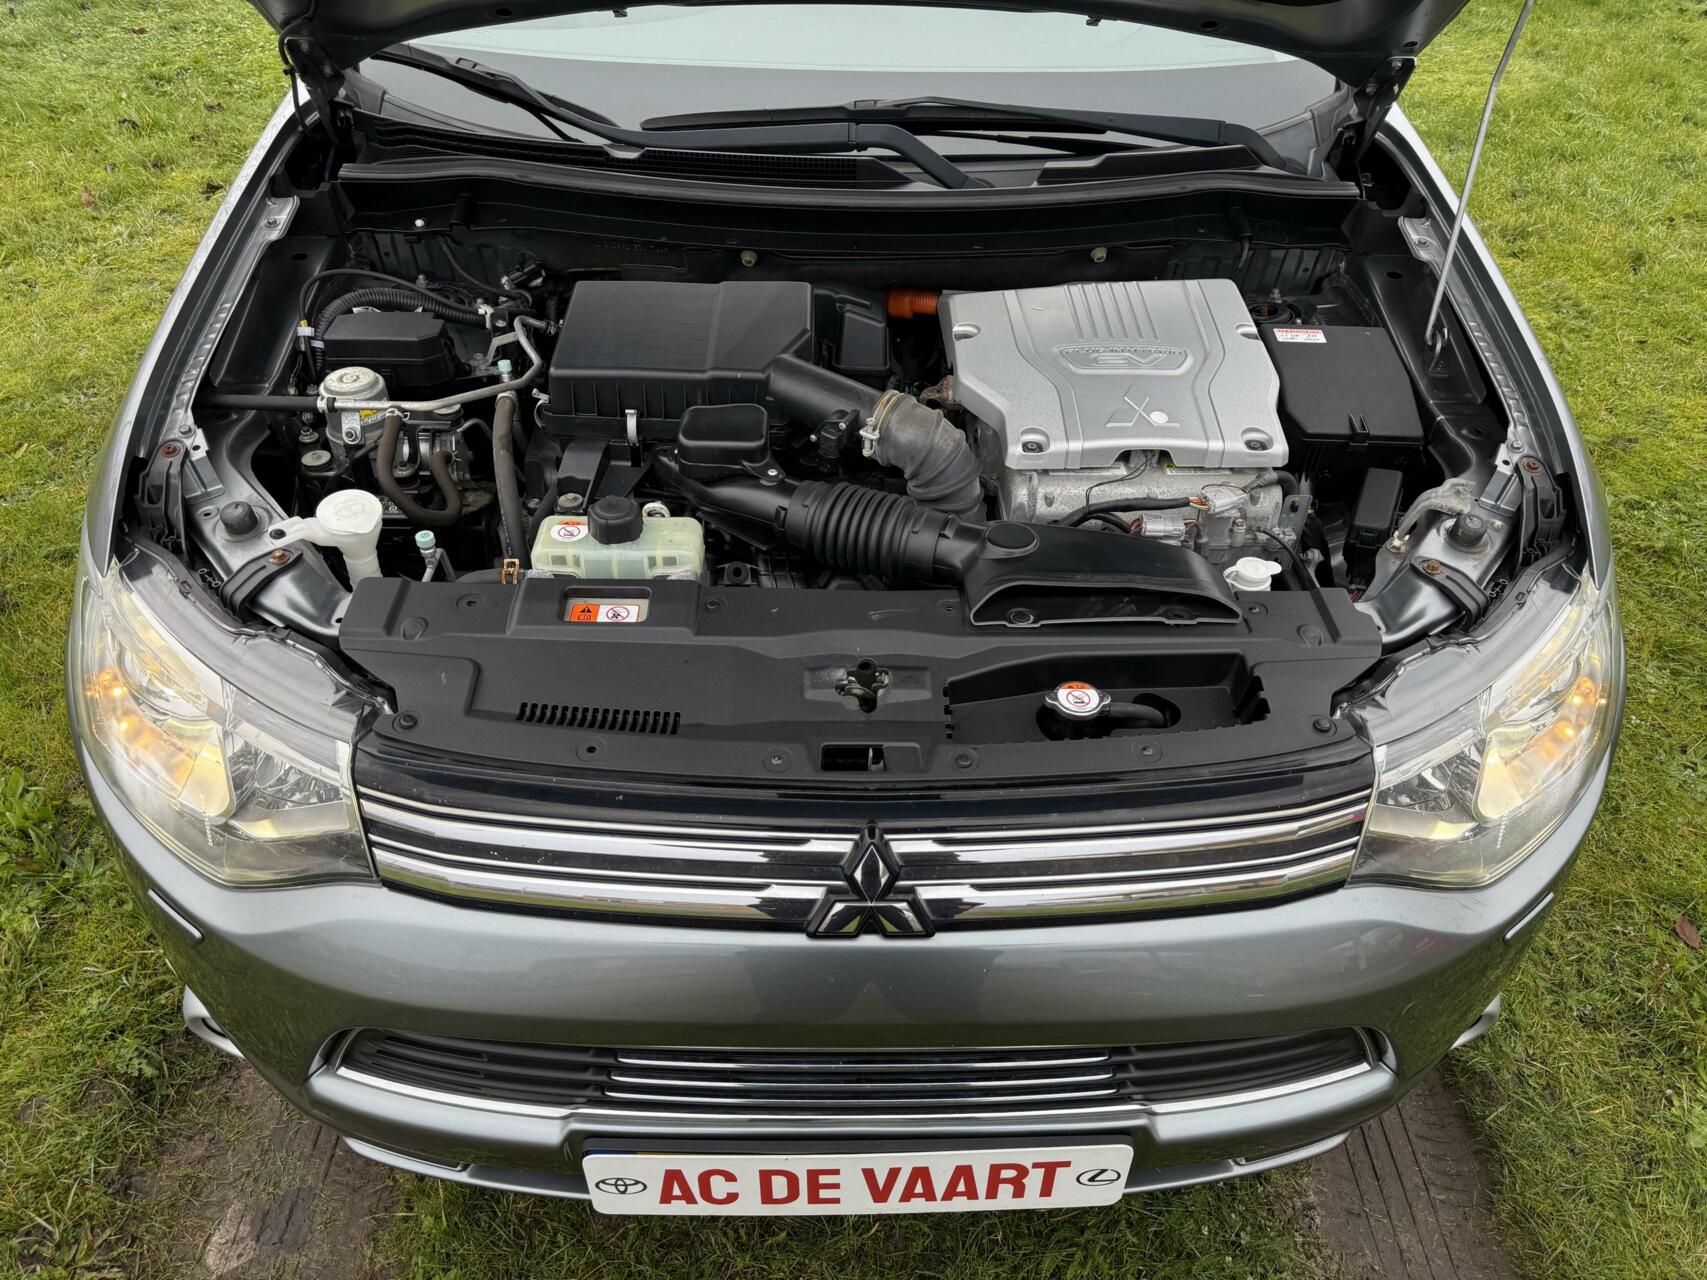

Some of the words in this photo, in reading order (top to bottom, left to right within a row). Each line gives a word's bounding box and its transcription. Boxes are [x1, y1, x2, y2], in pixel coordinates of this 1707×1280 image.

[659, 1169, 739, 1205] AC
[759, 1169, 840, 1205] DE
[862, 1160, 1072, 1204] VAART
